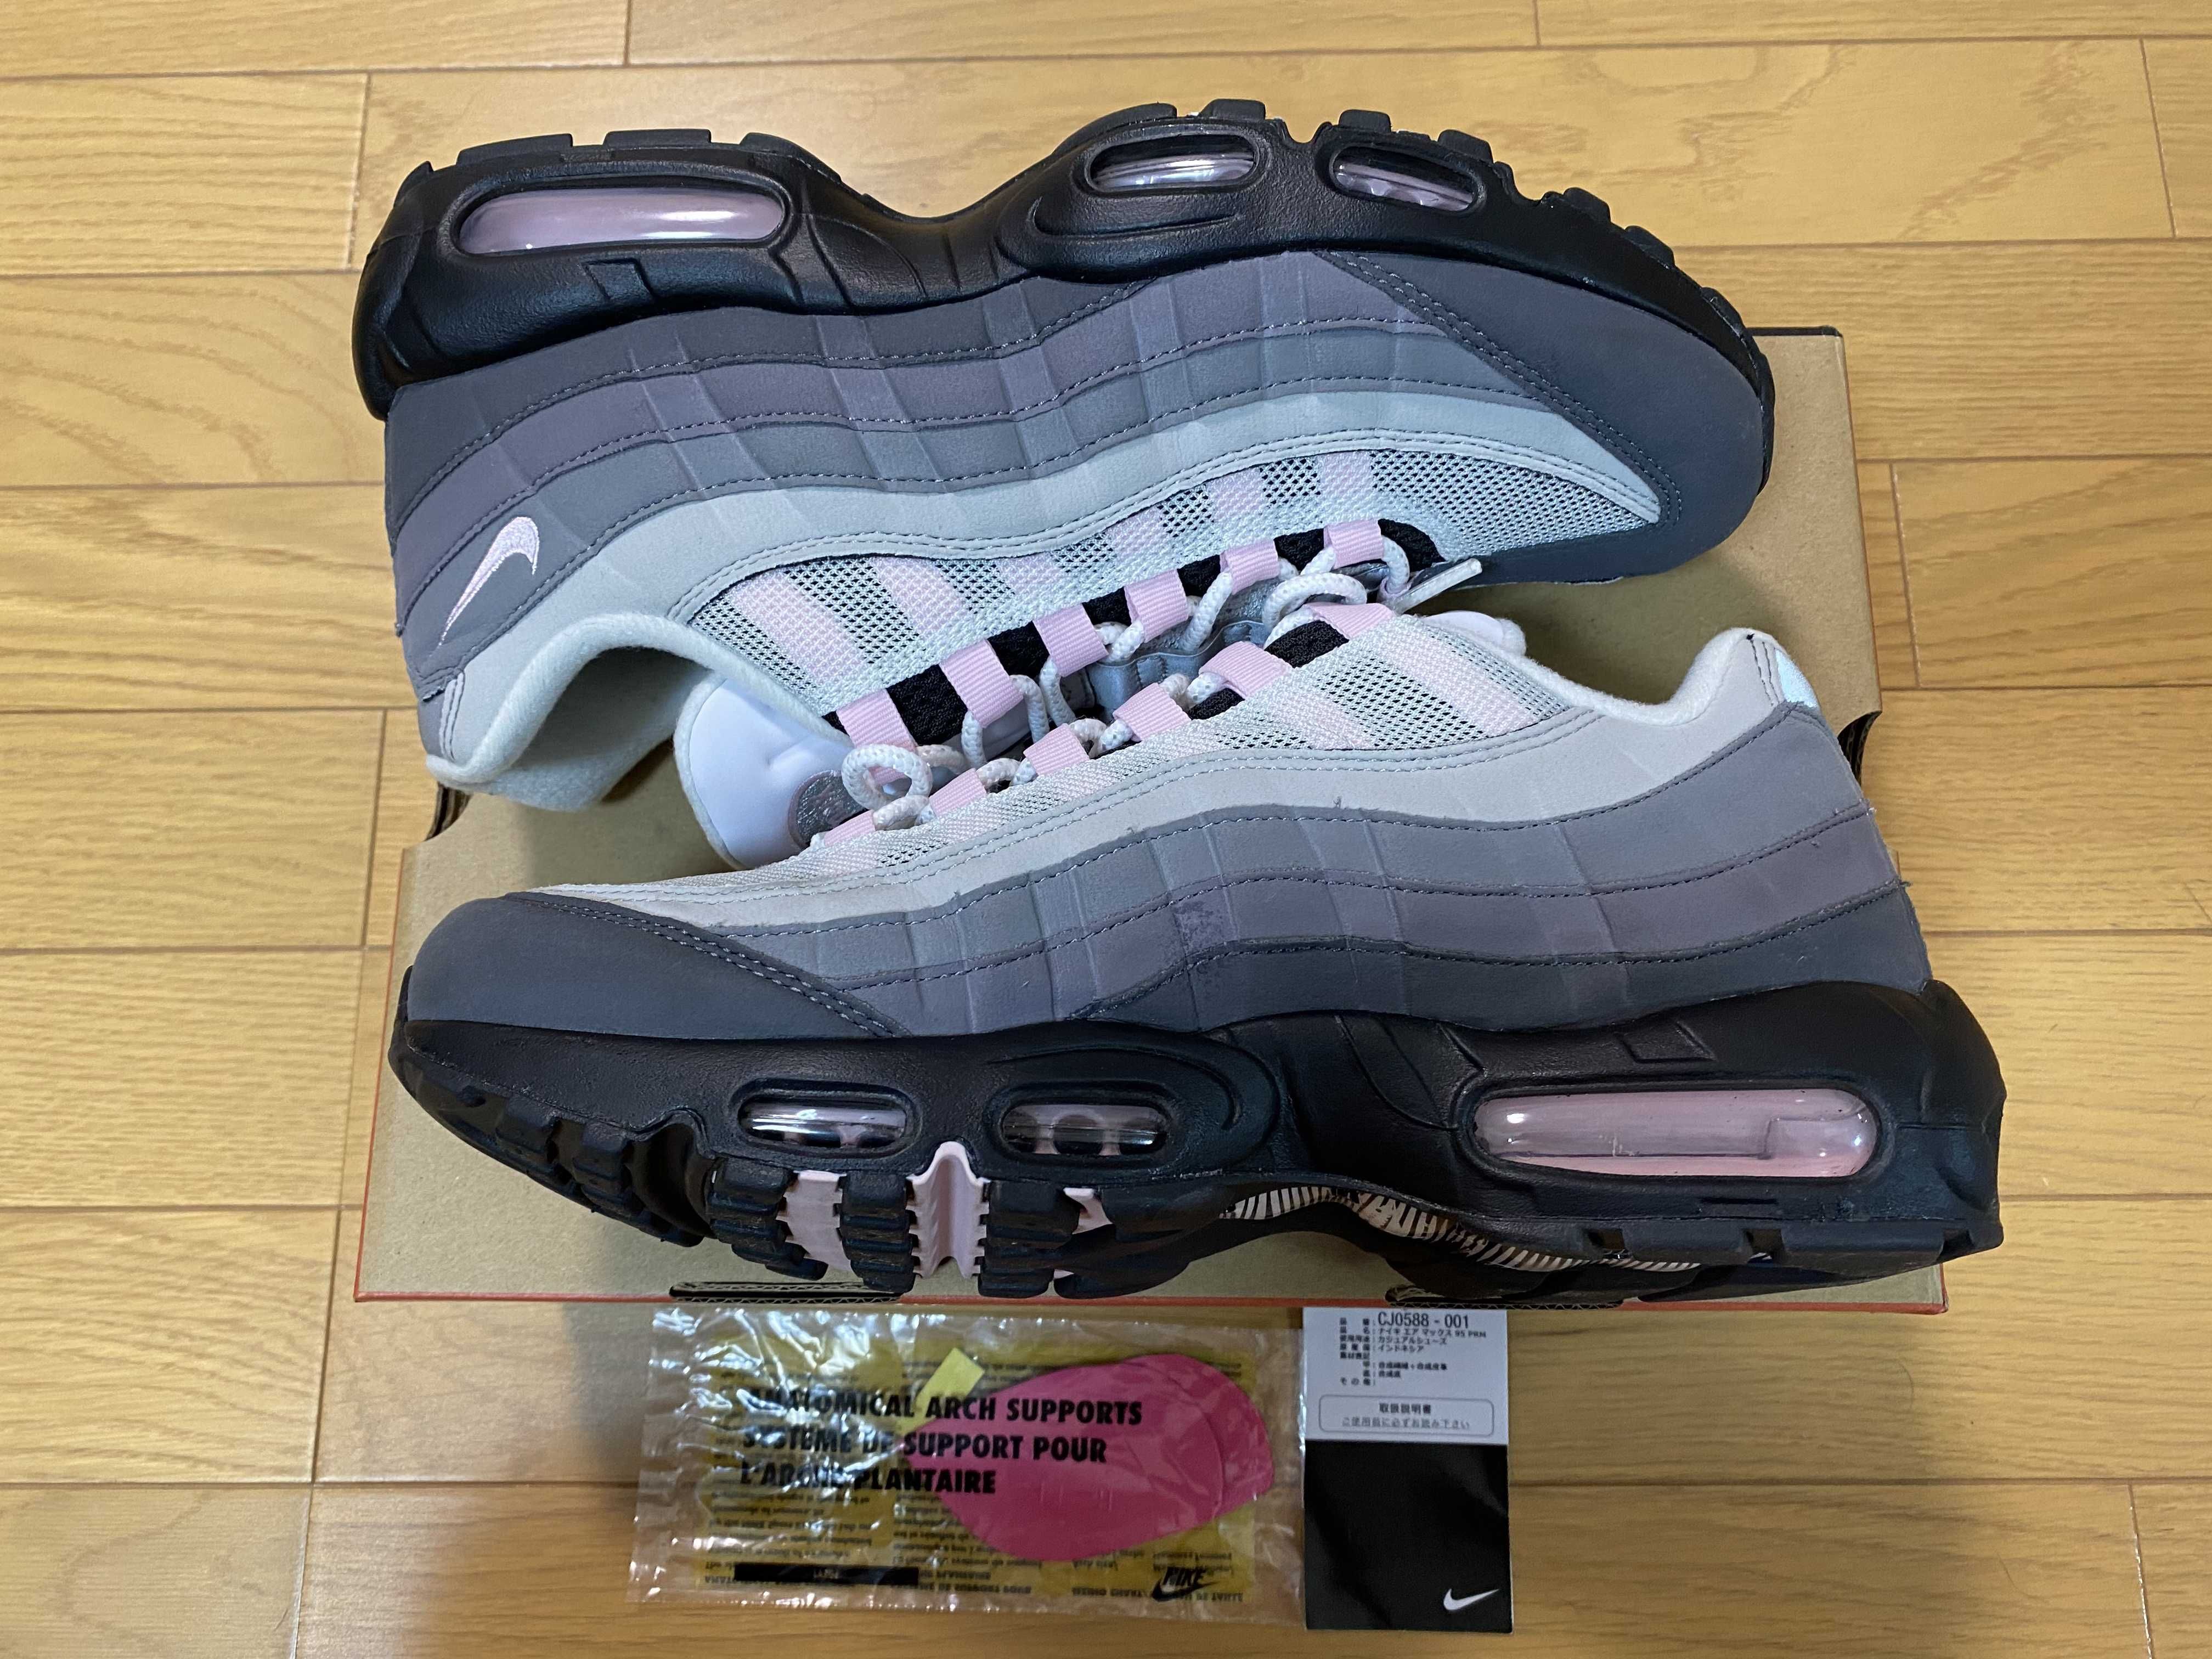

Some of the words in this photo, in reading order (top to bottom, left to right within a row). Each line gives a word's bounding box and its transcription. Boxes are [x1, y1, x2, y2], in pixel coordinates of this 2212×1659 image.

[1378, 1311, 1429, 1327] CJ0588
[1444, 1314, 1469, 1329] 001
[925, 1396, 996, 1420] ARCH
[1006, 1398, 1143, 1425] SUPPORTS
[903, 1431, 1024, 1460] SUPPORT
[1032, 1436, 1108, 1464] POUR
